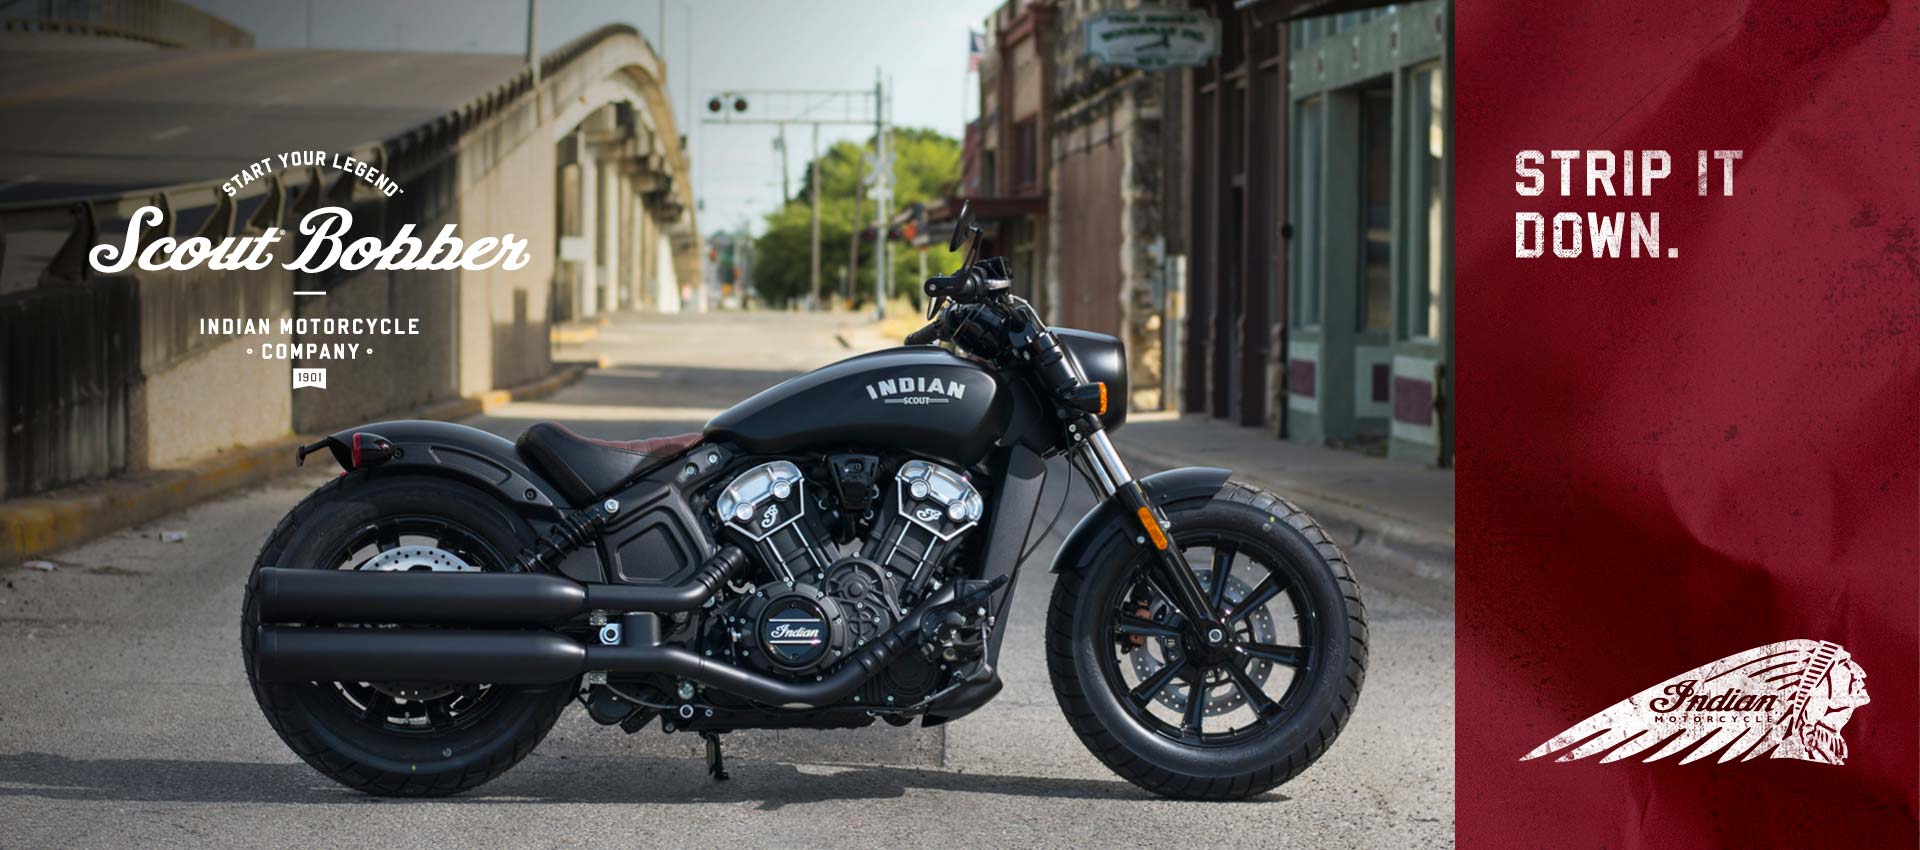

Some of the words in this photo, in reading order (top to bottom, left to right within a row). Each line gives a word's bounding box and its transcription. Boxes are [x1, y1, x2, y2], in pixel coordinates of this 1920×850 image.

[866, 377, 966, 400] INDIAN
[903, 396, 930, 405] SCOUT
[770, 624, 819, 638] Indian
